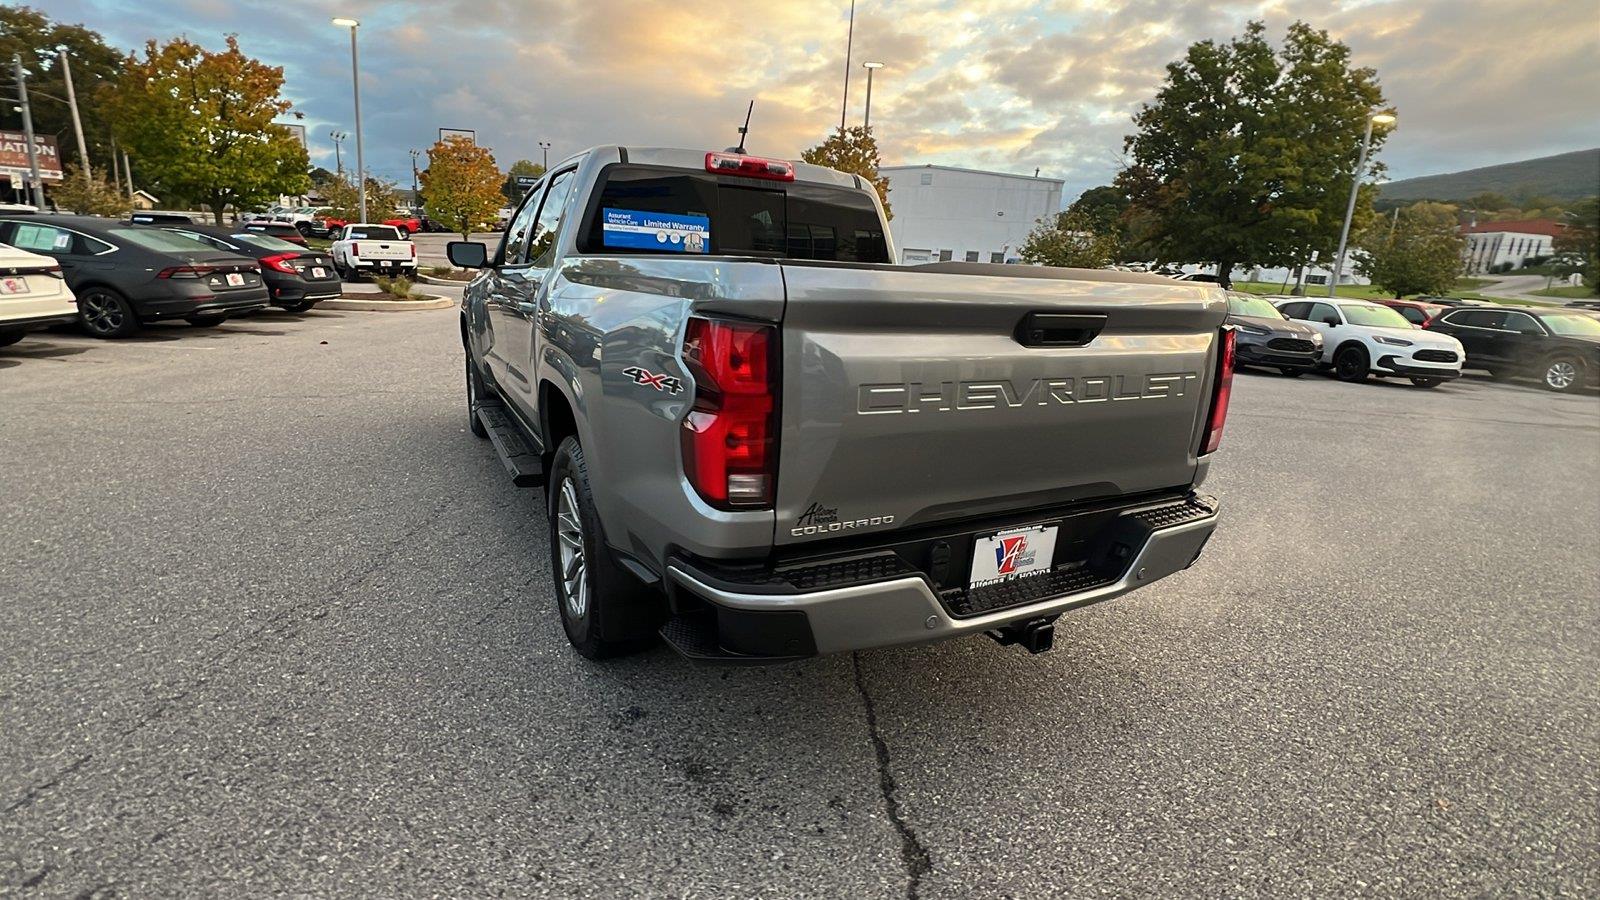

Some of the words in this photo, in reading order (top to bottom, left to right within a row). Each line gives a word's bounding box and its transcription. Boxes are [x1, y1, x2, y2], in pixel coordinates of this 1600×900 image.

[643, 219, 671, 229] Limited
[671, 221, 705, 232] Warranty
[858, 372, 1197, 414] CHEVROLET
[791, 515, 895, 537] COLORADO
